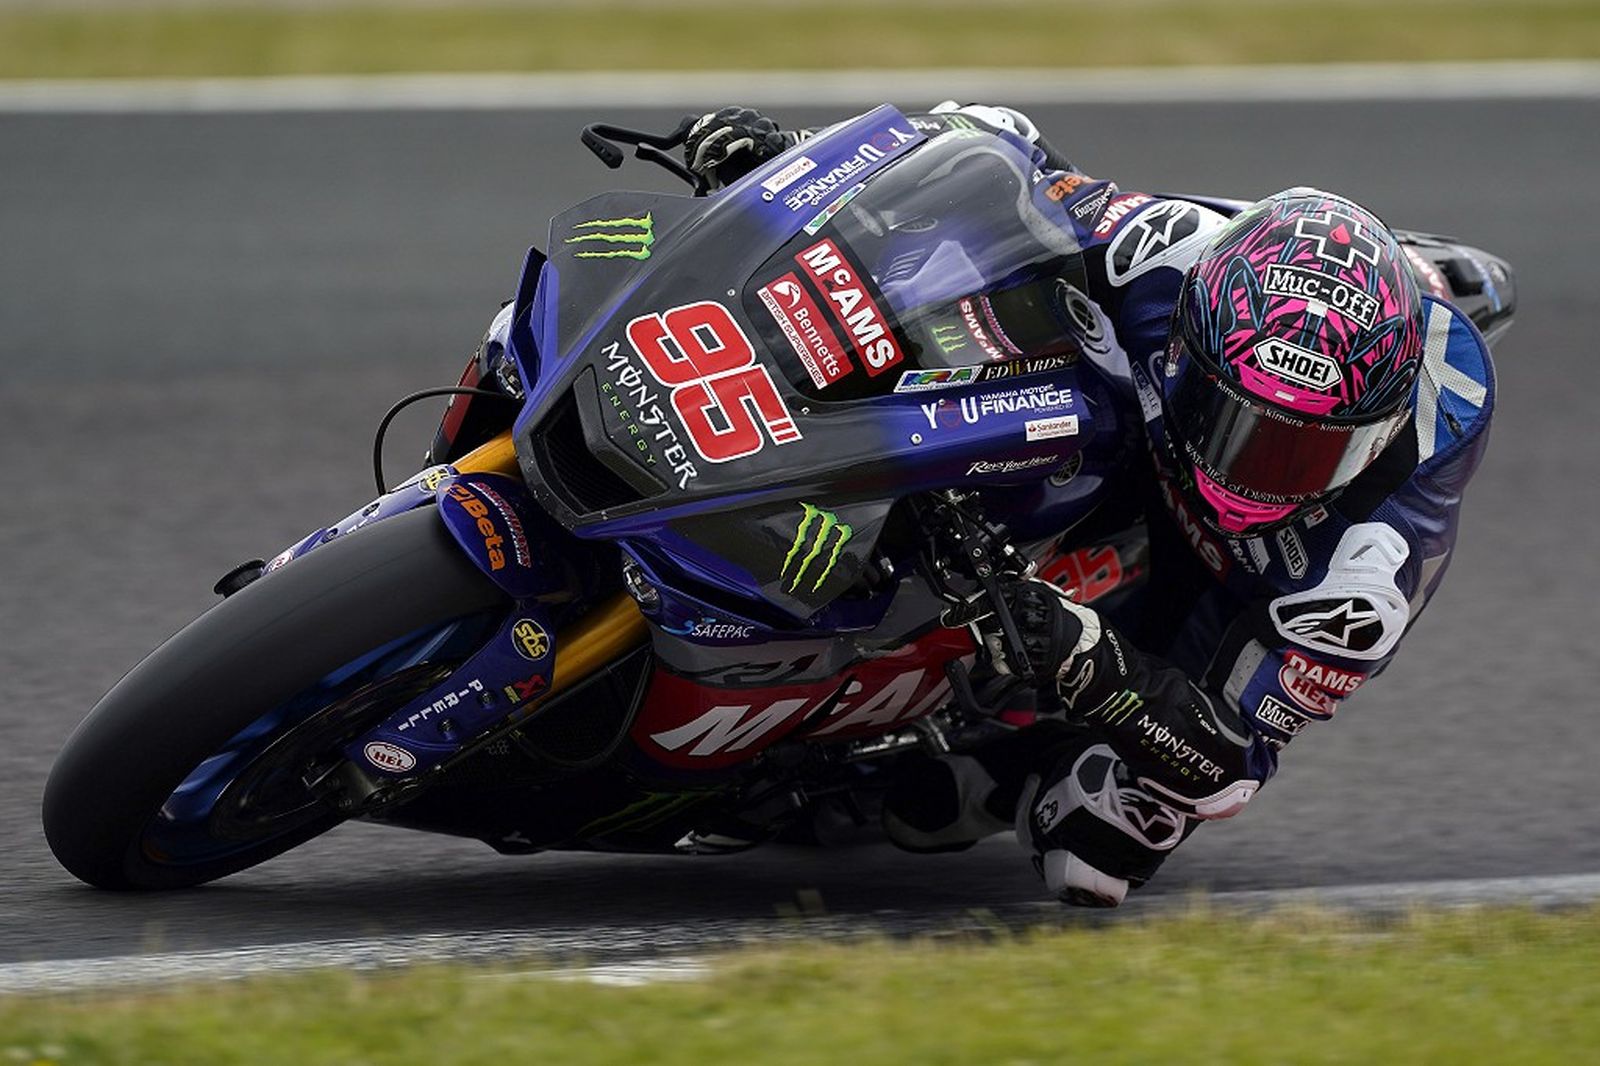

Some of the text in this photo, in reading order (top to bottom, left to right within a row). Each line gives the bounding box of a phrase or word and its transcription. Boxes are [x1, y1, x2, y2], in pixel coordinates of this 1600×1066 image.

[785, 160, 871, 212] FINANCE
[803, 243, 895, 368] McAMS
[793, 308, 841, 377] Bennetts
[1267, 345, 1331, 384] SHOEI
[626, 301, 803, 463] 95
[980, 390, 1019, 401] YAMAHA
[981, 389, 1074, 416] FINANCE
[602, 382, 657, 470] ENERGY
[459, 496, 507, 572] Beta
[1280, 527, 1304, 573] SHOEI
[691, 623, 755, 639] SAFEPAC
[398, 678, 484, 731] PIRELLI
